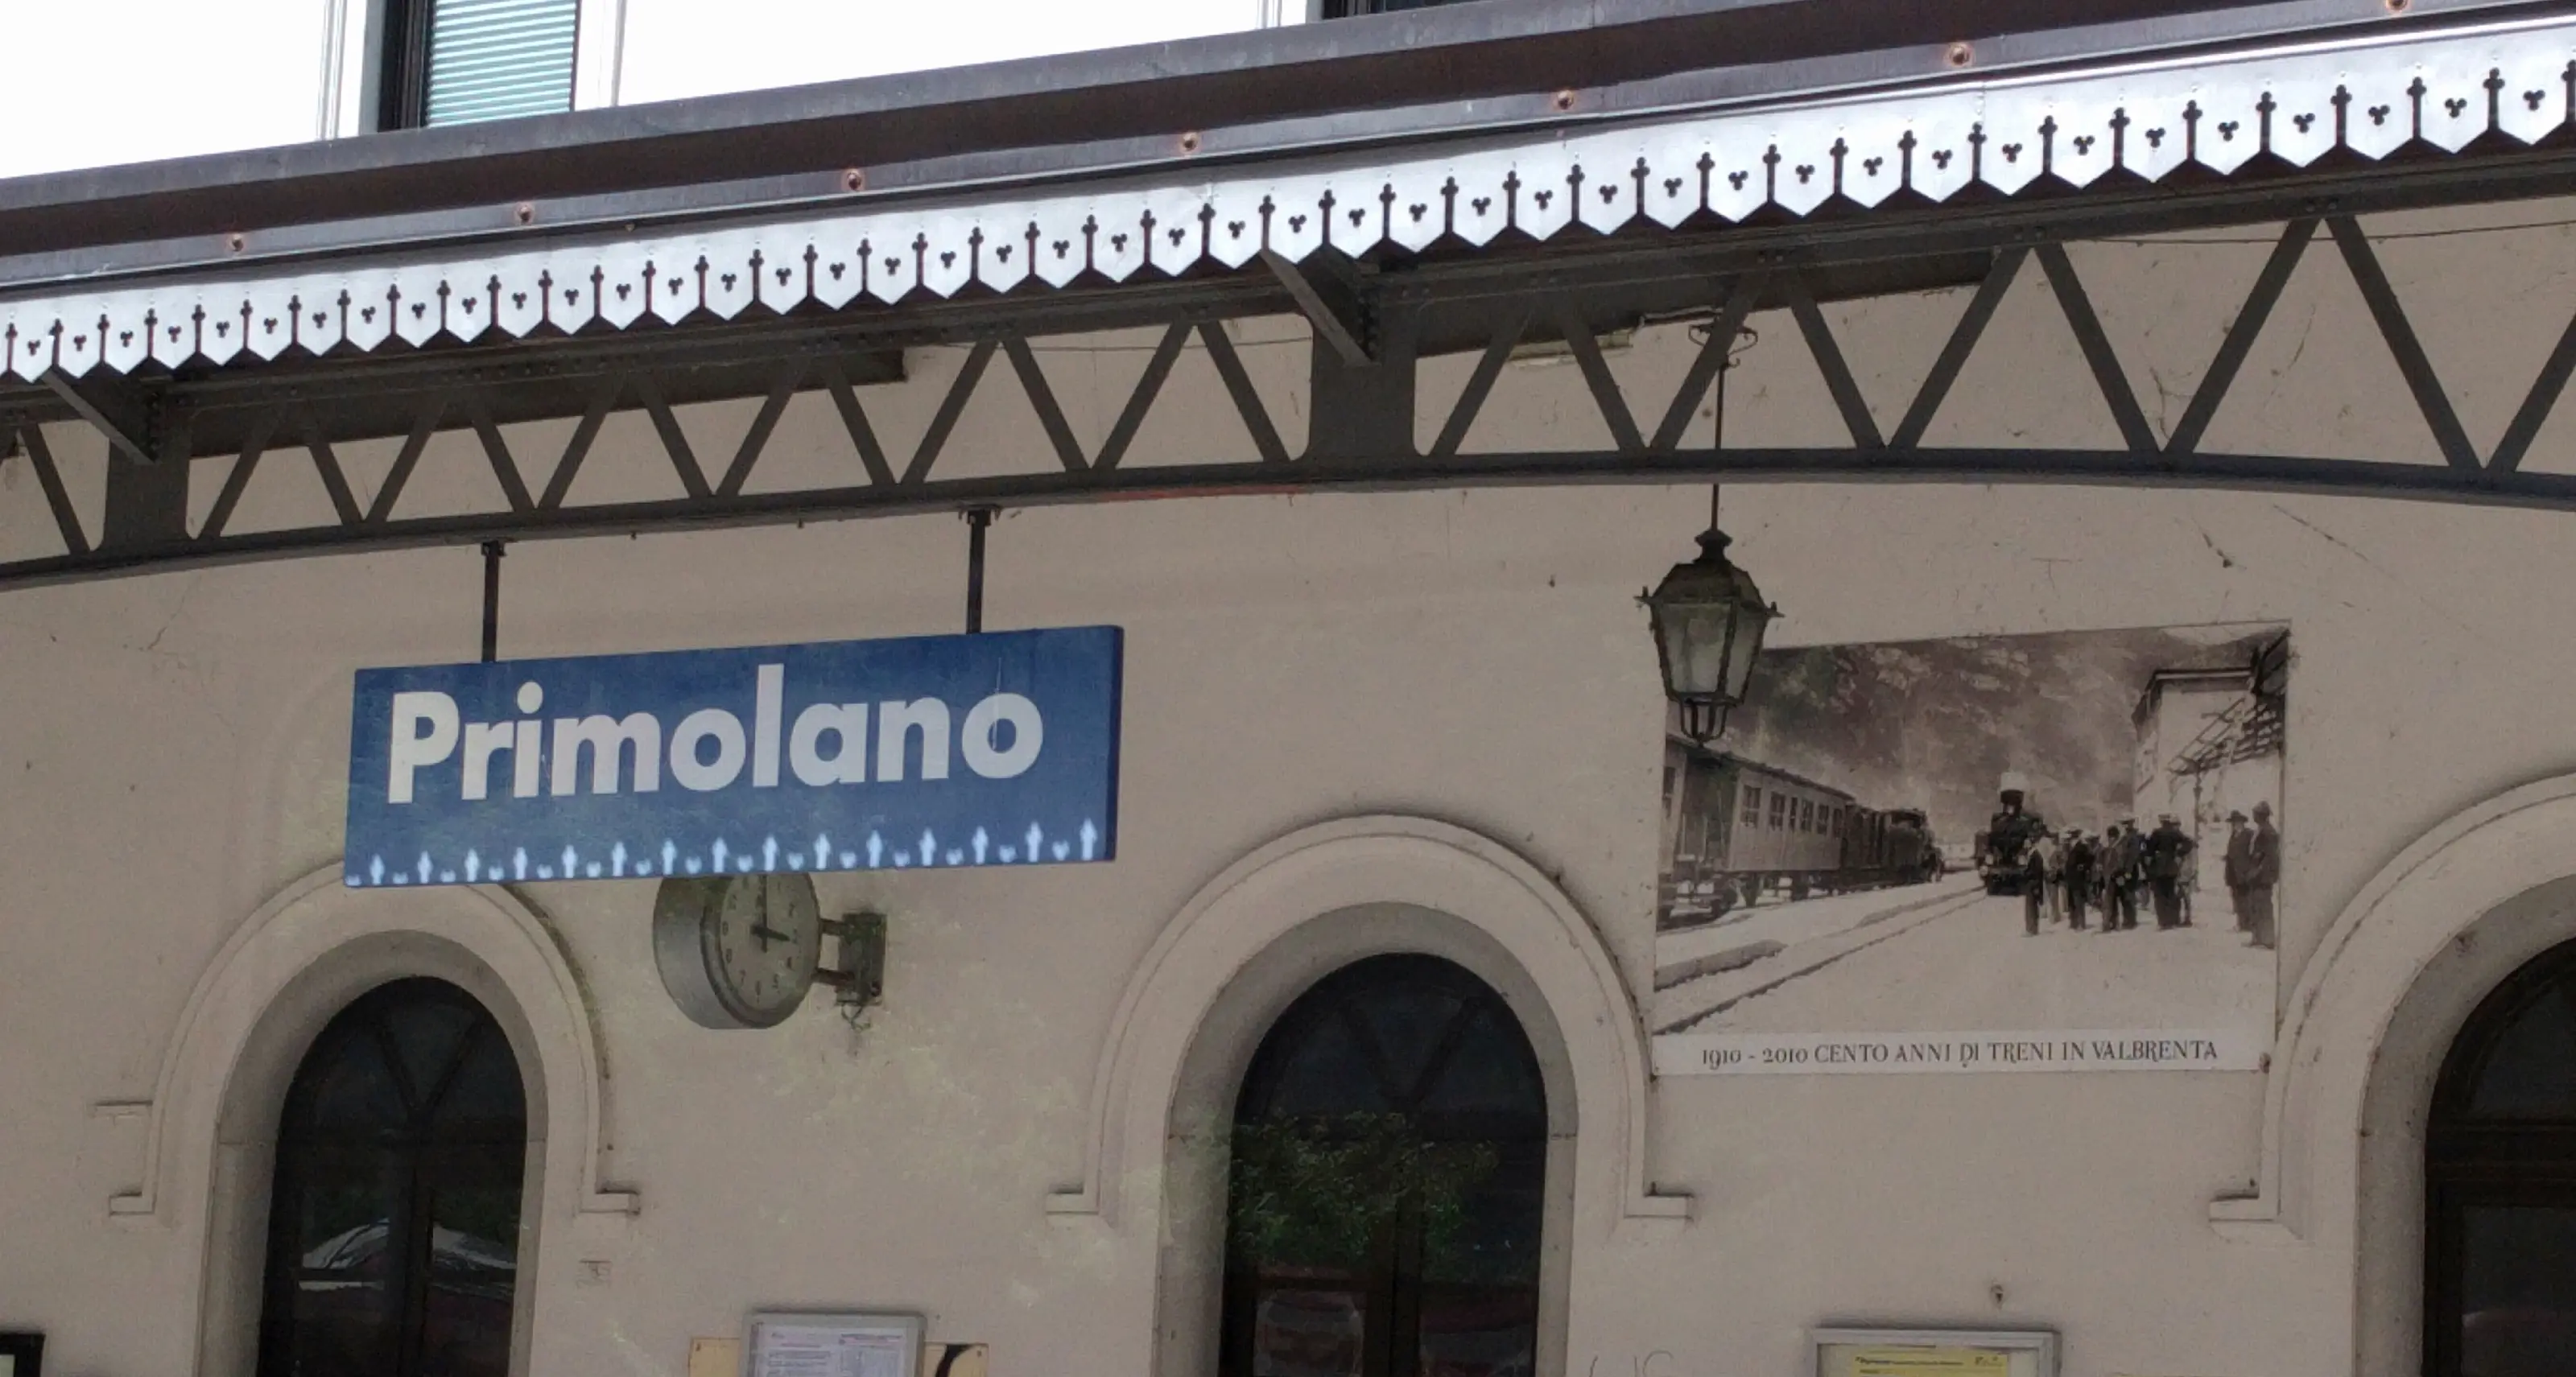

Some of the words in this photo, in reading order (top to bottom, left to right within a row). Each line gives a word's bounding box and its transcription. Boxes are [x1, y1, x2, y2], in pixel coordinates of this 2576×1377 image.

[388, 663, 1043, 803] Primolano
[1702, 1049, 1741, 1070] 1910
[1762, 1047, 1808, 1065] 2010
[1814, 1044, 1889, 1064] CENTO
[1894, 1043, 1951, 1063] ANNI
[1959, 1043, 1979, 1068] DI
[1988, 1042, 2053, 1063] TRENI
[2062, 1042, 2086, 1062] IN
[2092, 1041, 2219, 1062] VALBRENTA
